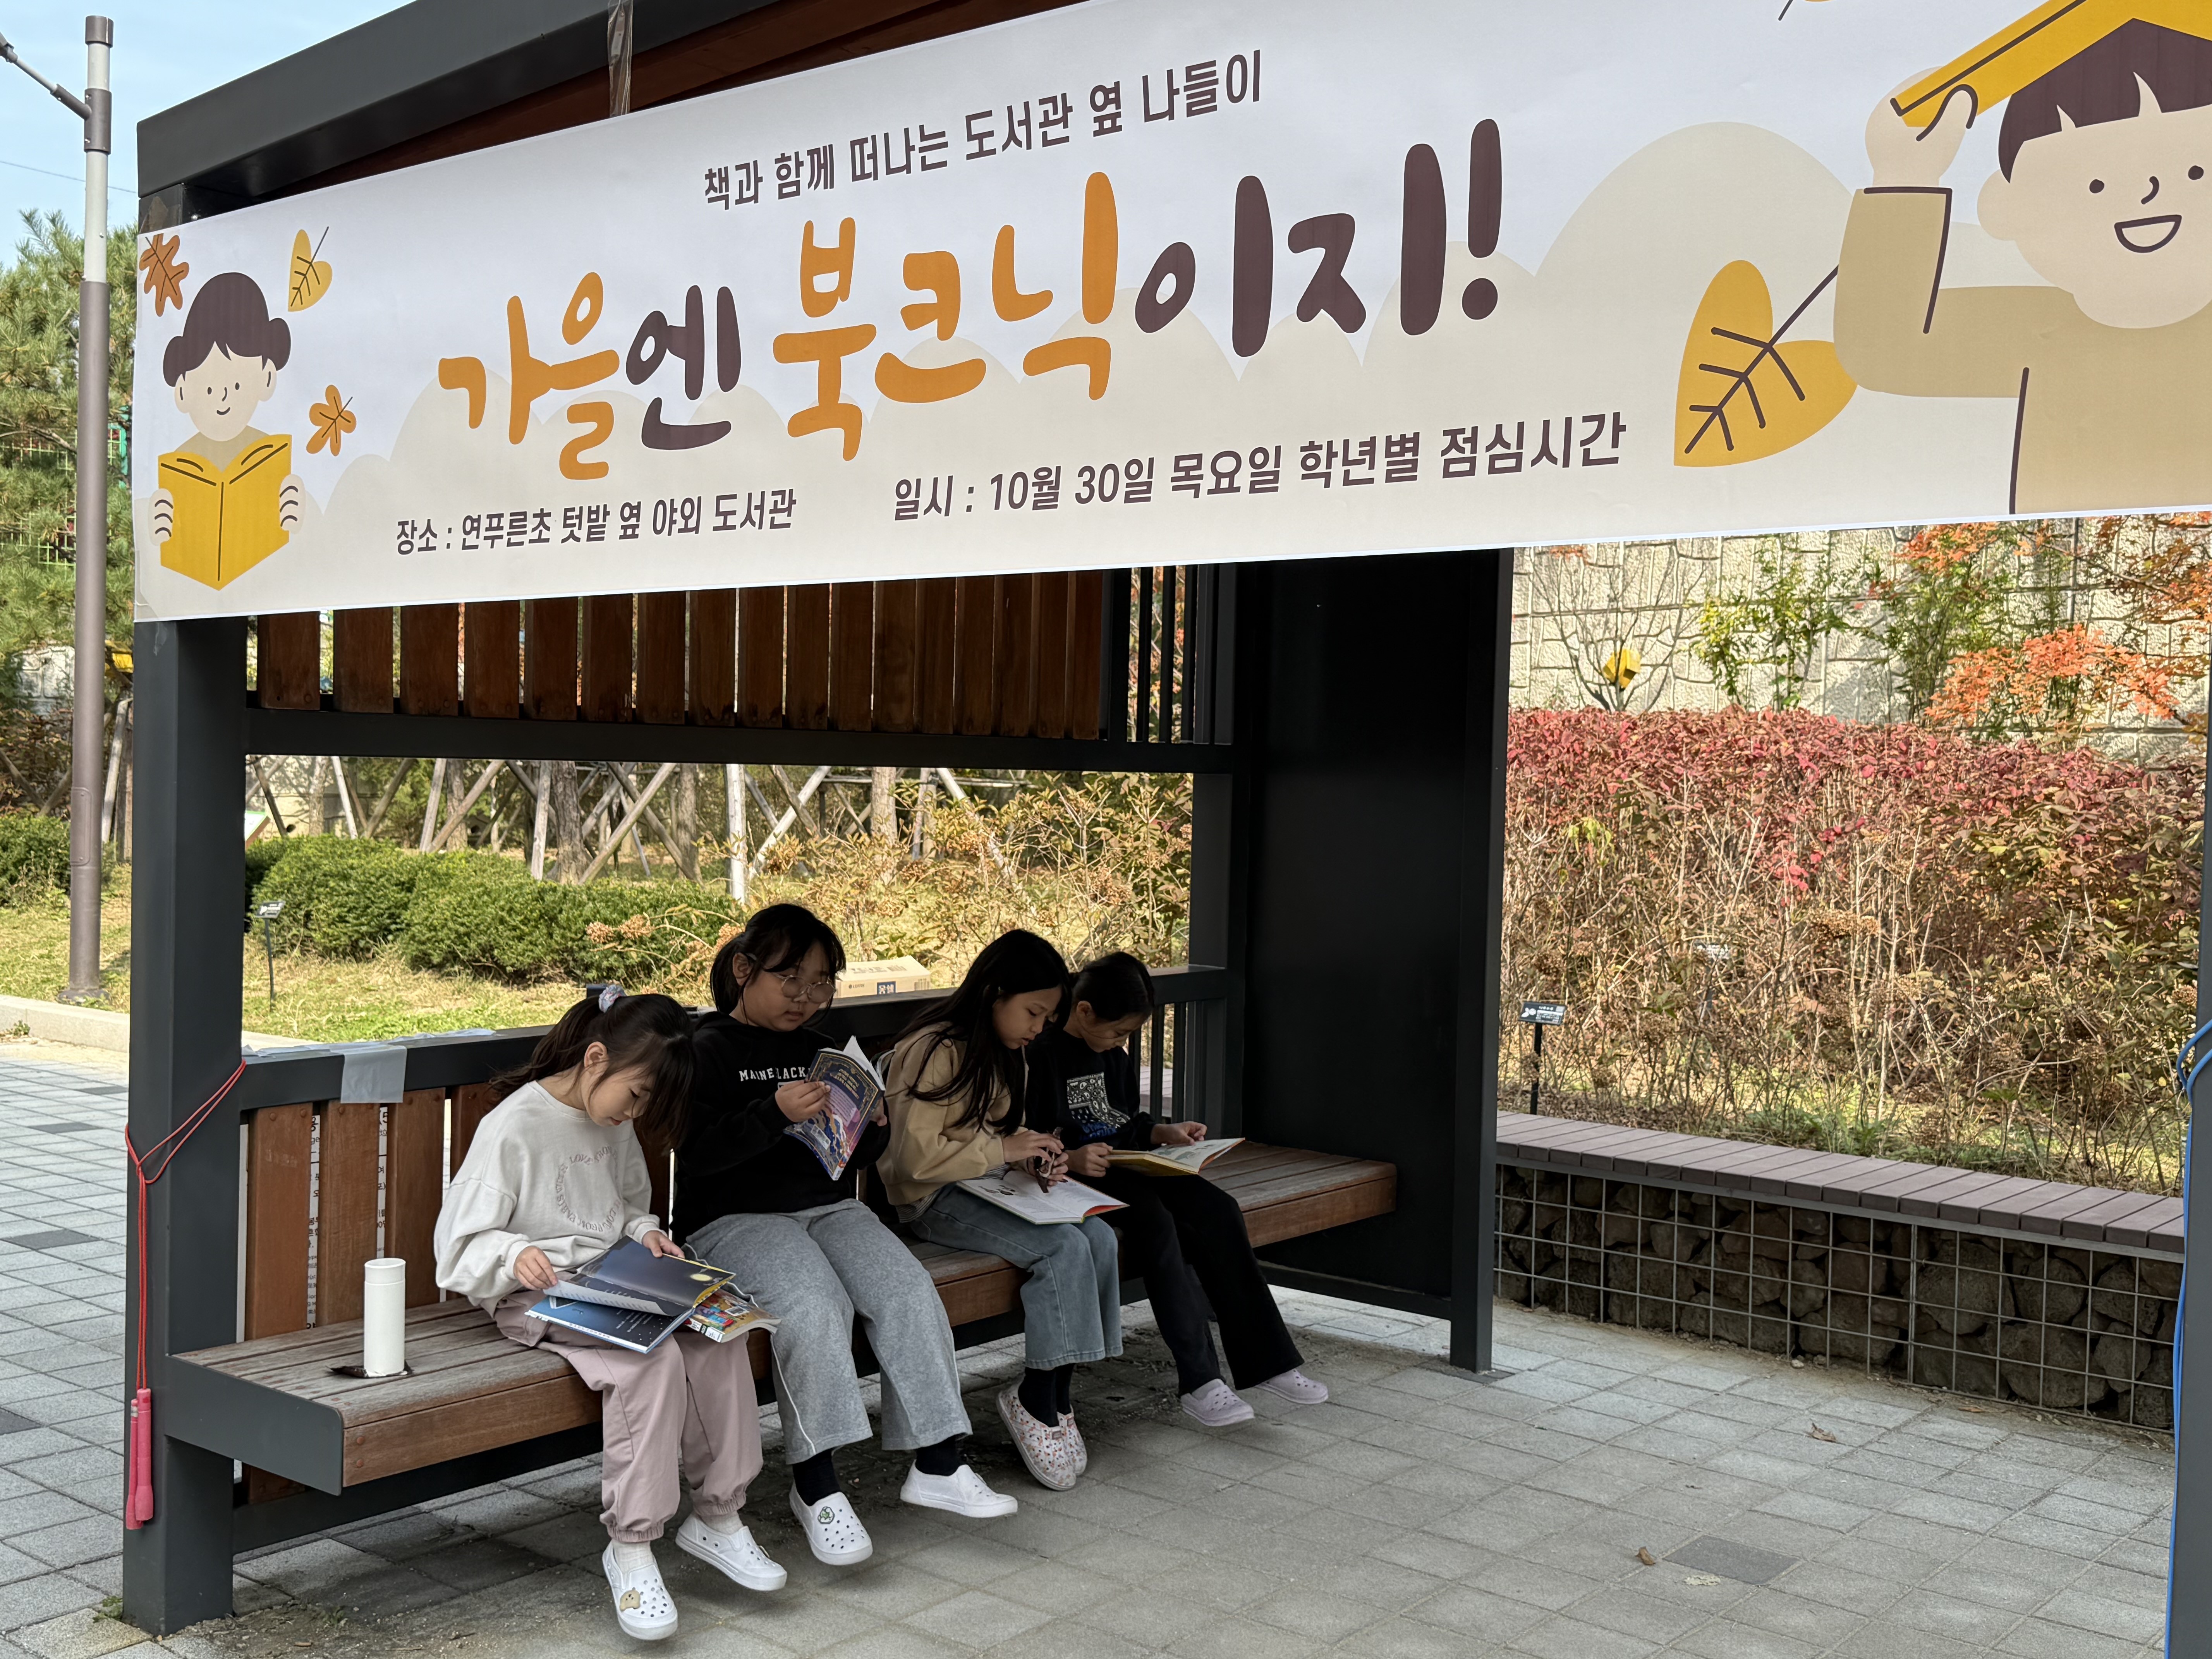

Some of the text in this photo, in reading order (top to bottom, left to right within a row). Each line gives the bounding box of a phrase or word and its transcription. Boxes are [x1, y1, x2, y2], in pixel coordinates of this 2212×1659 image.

[705, 50, 1260, 210] 책과 함께 떠나는 도서관 옆 나들이
[439, 119, 1502, 479] 가을엔 북크닉이지!
[895, 476, 953, 520] 일시
[991, 466, 1061, 510] 10월
[1075, 457, 1154, 504] 30일
[1171, 445, 1281, 498] 목요일
[1300, 432, 1420, 488] 학년별
[1441, 412, 1626, 478] 점심시간
[397, 519, 437, 555] 장소
[462, 508, 551, 550] 연푸른초
[561, 504, 610, 543] 텃밭
[619, 501, 641, 539] 옆
[653, 496, 701, 536] 야외
[713, 489, 796, 531] 도서관
[739, 1068, 775, 1081] MAINE
[569, 1154, 592, 1166] LOVE
